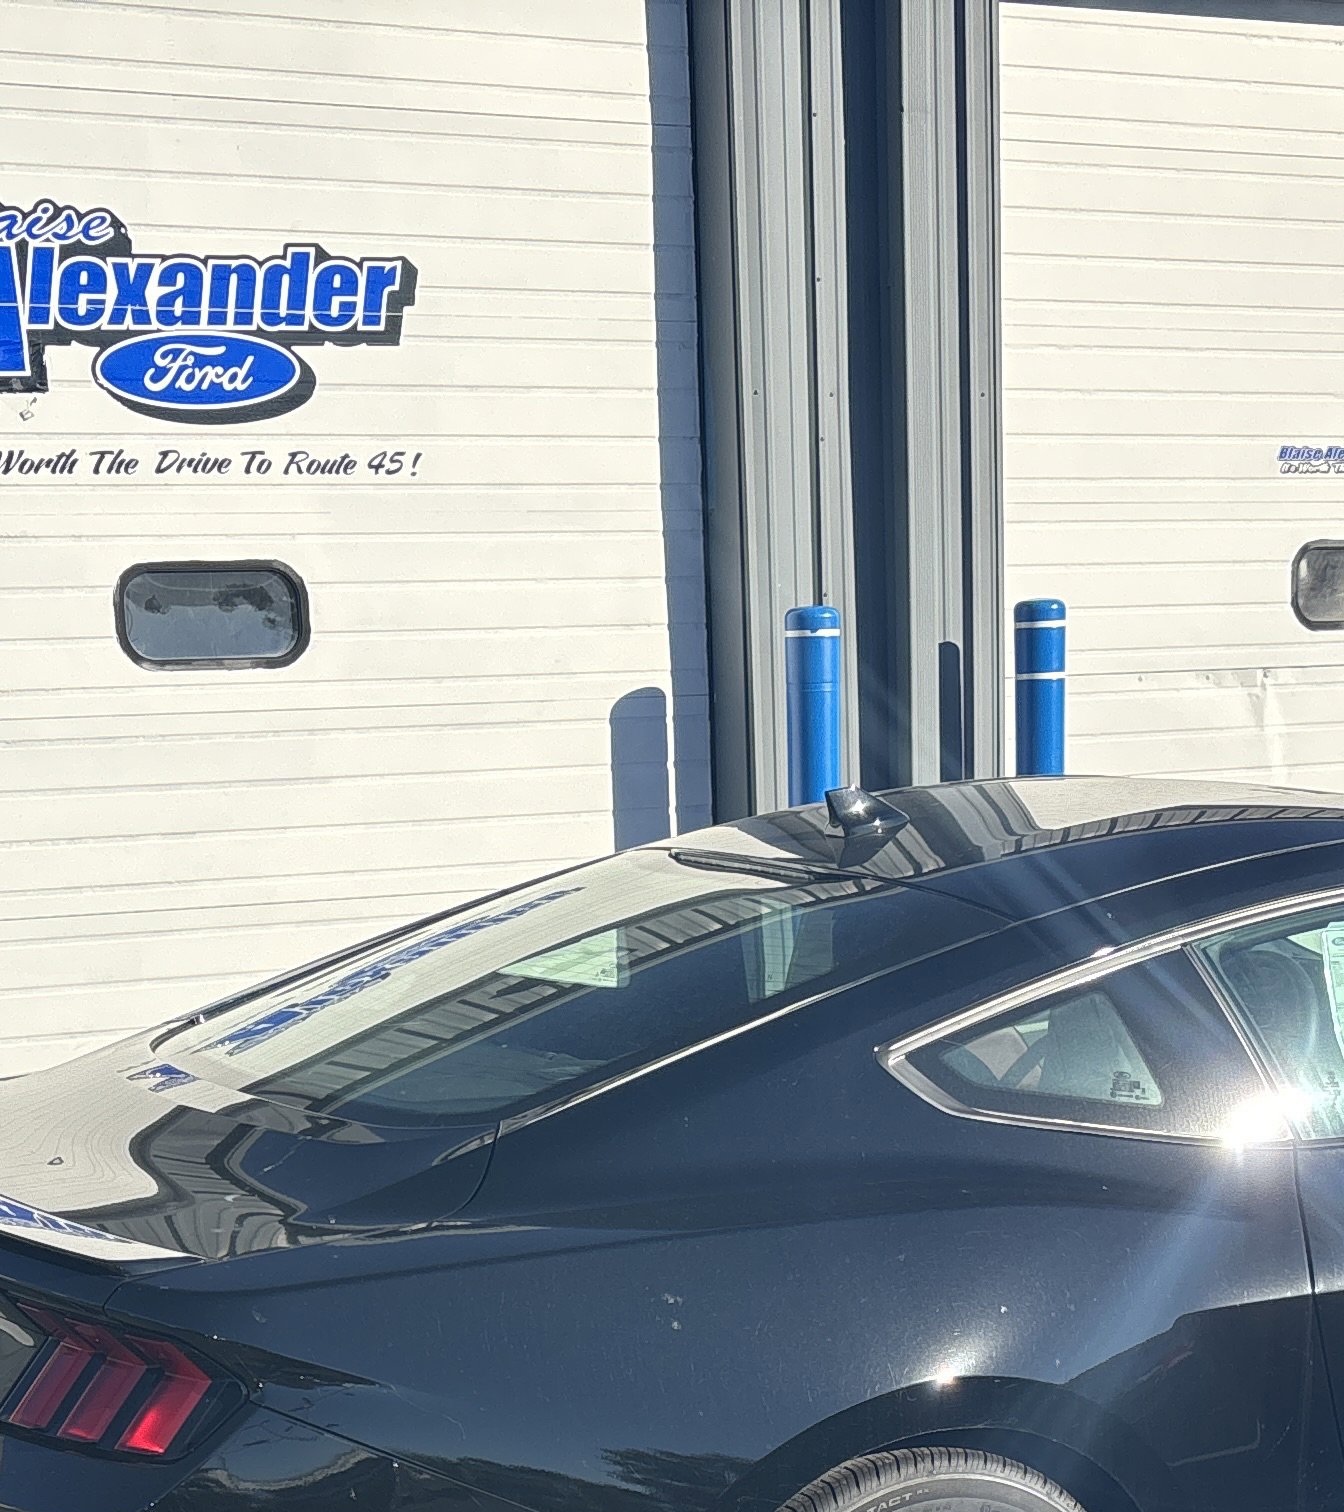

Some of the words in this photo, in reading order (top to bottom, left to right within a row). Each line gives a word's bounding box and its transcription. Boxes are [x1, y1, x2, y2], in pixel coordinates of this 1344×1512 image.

[143, 342, 255, 391] Ford
[89, 449, 139, 475] The
[155, 450, 232, 476] Drive
[240, 451, 273, 475] To
[283, 450, 358, 476] Route
[367, 451, 424, 477] 45!
